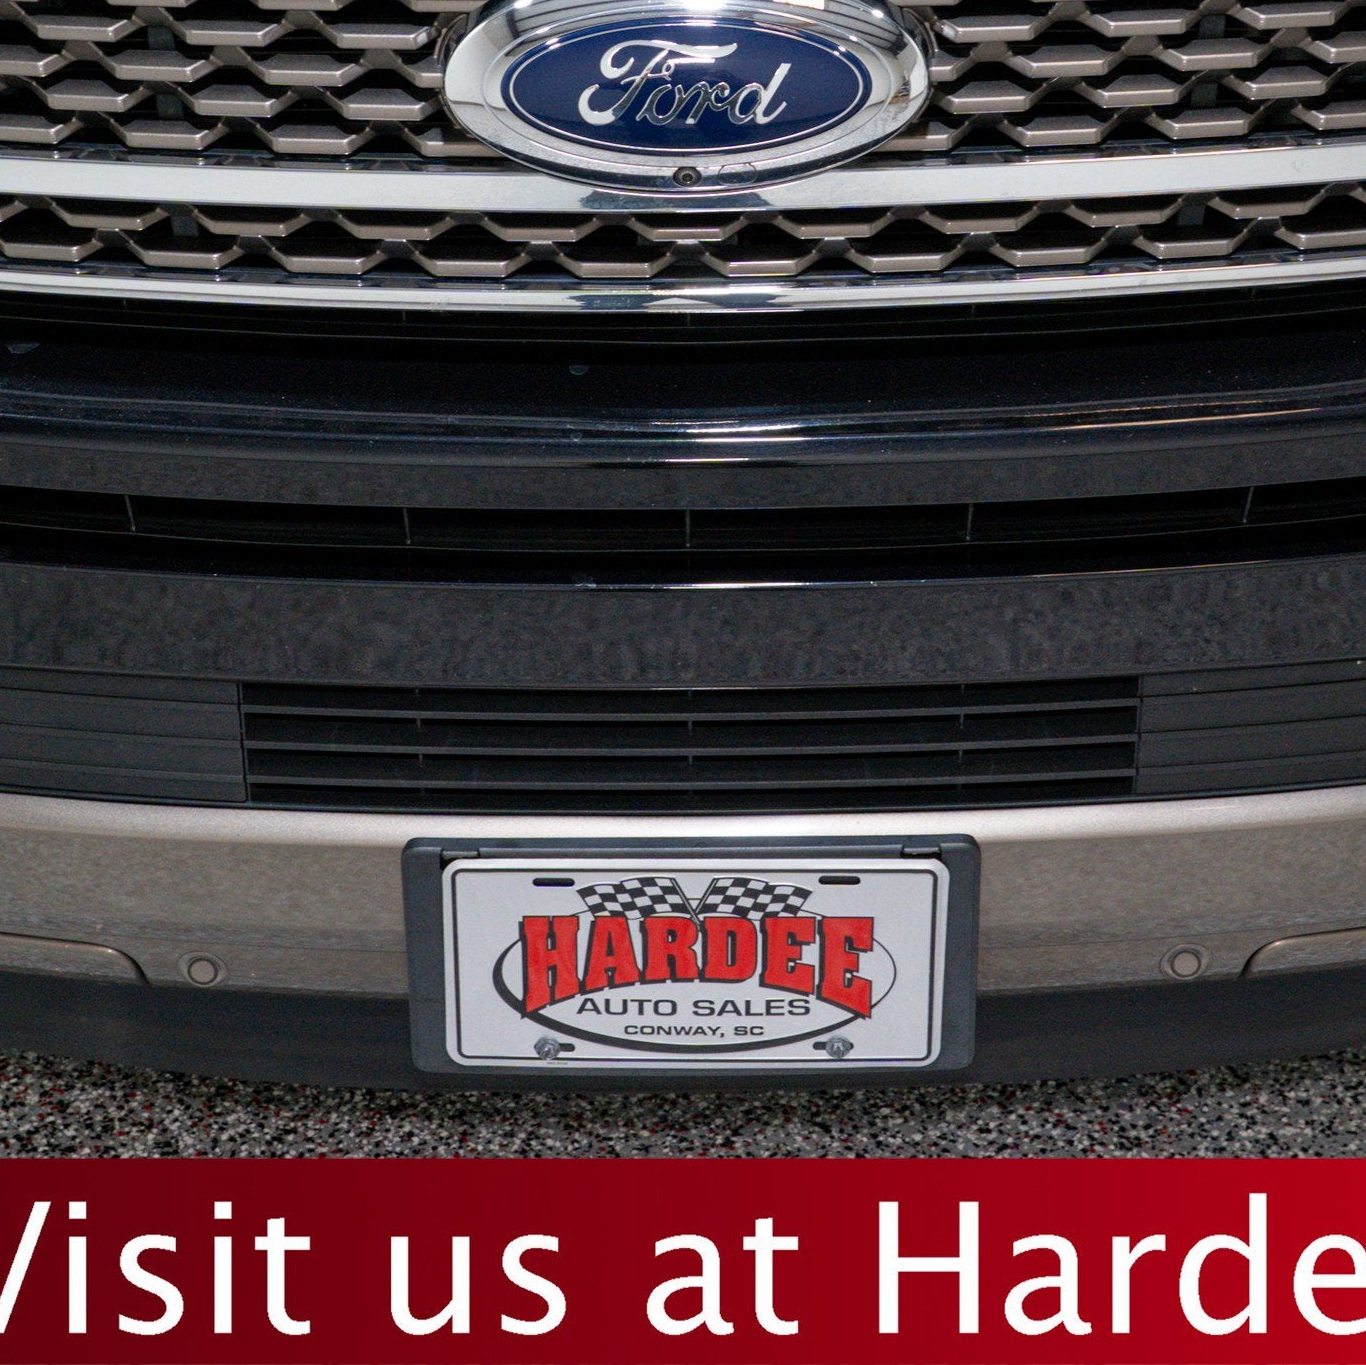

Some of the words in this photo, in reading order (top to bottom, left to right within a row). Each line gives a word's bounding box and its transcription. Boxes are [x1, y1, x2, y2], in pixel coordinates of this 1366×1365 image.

[577, 39, 792, 126] Ford
[518, 916, 874, 1018] HARDEE
[576, 998, 678, 1016] AUTO
[692, 999, 811, 1017] SALES
[623, 1025, 725, 1038] CONWAY,
[733, 1025, 765, 1036] SC
